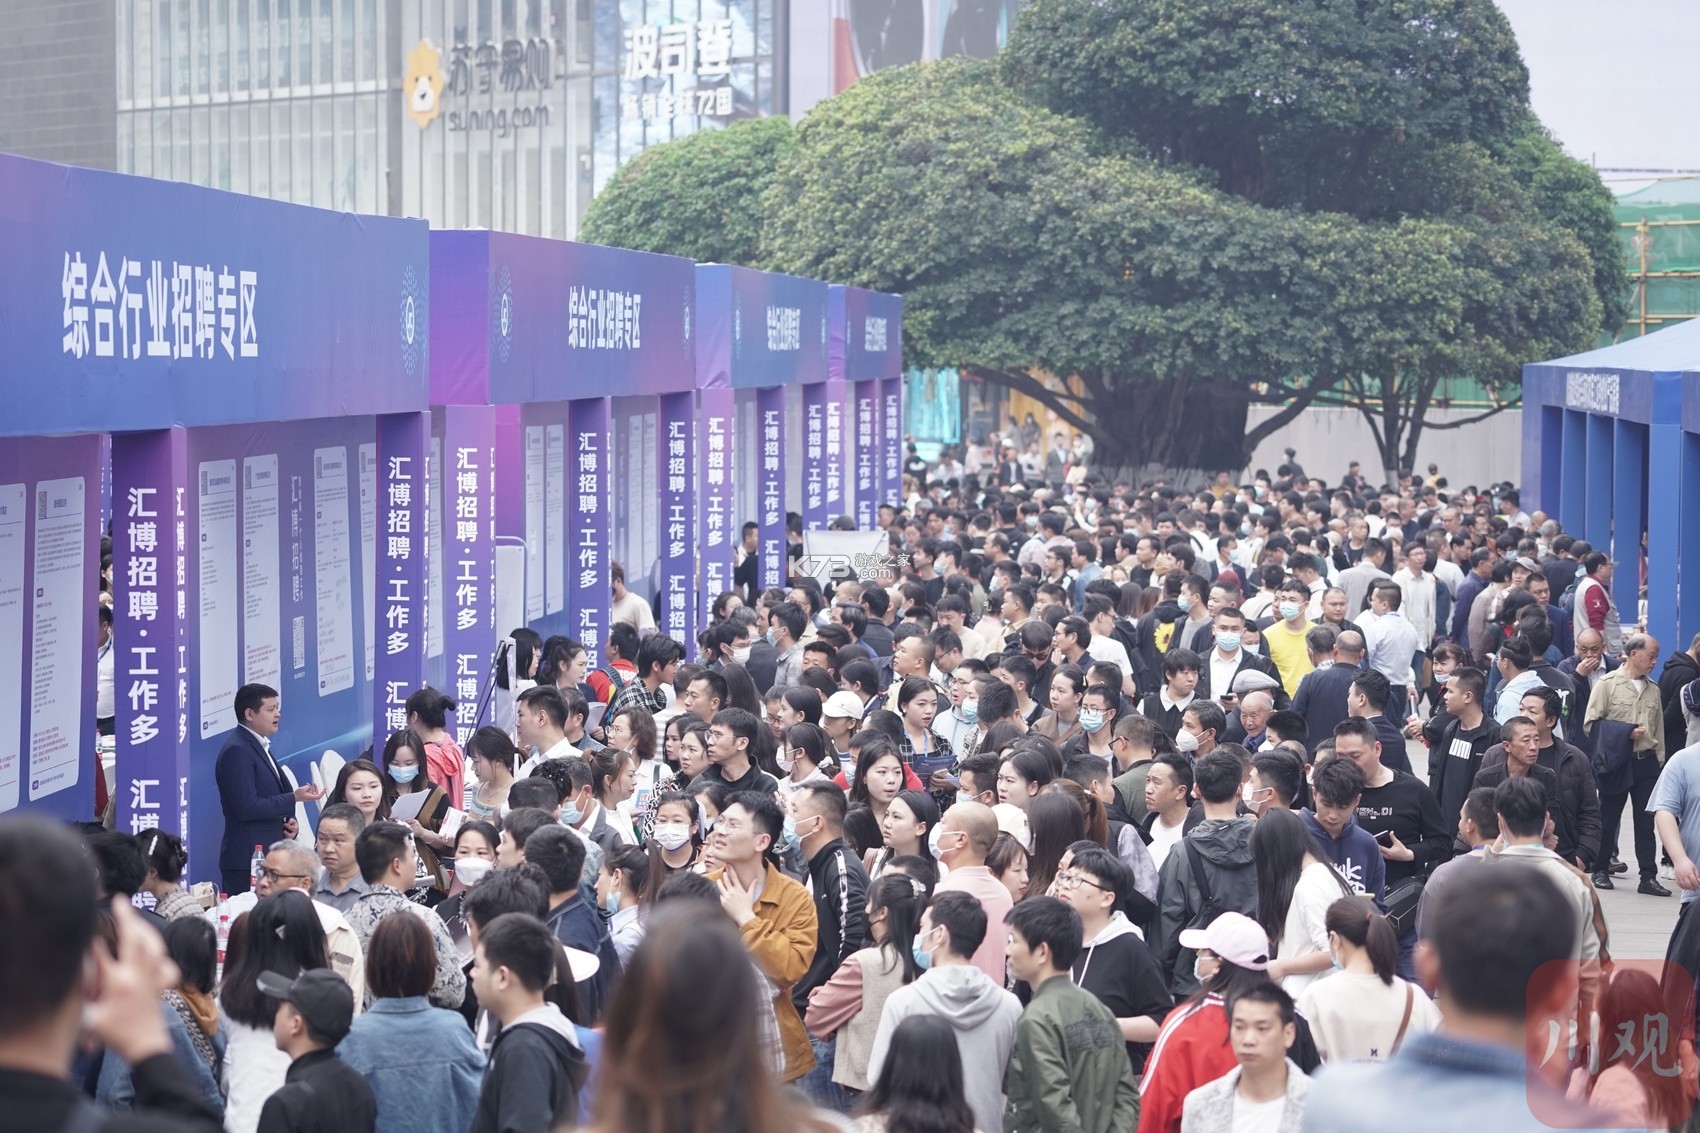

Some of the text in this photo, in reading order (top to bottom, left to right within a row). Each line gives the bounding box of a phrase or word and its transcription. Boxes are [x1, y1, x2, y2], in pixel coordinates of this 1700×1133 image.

[624, 20, 733, 79] 波司登
[62, 251, 258, 361] 综合行业招聘专区
[568, 285, 641, 350] 综合行业招聘专区
[386, 456, 411, 655] 汇博招聘·工作多
[456, 447, 478, 630] 汇博招聘·工作多
[578, 432, 598, 589] 汇博招聘·工作多
[127, 486, 159, 746] 汇博招聘·工作多
